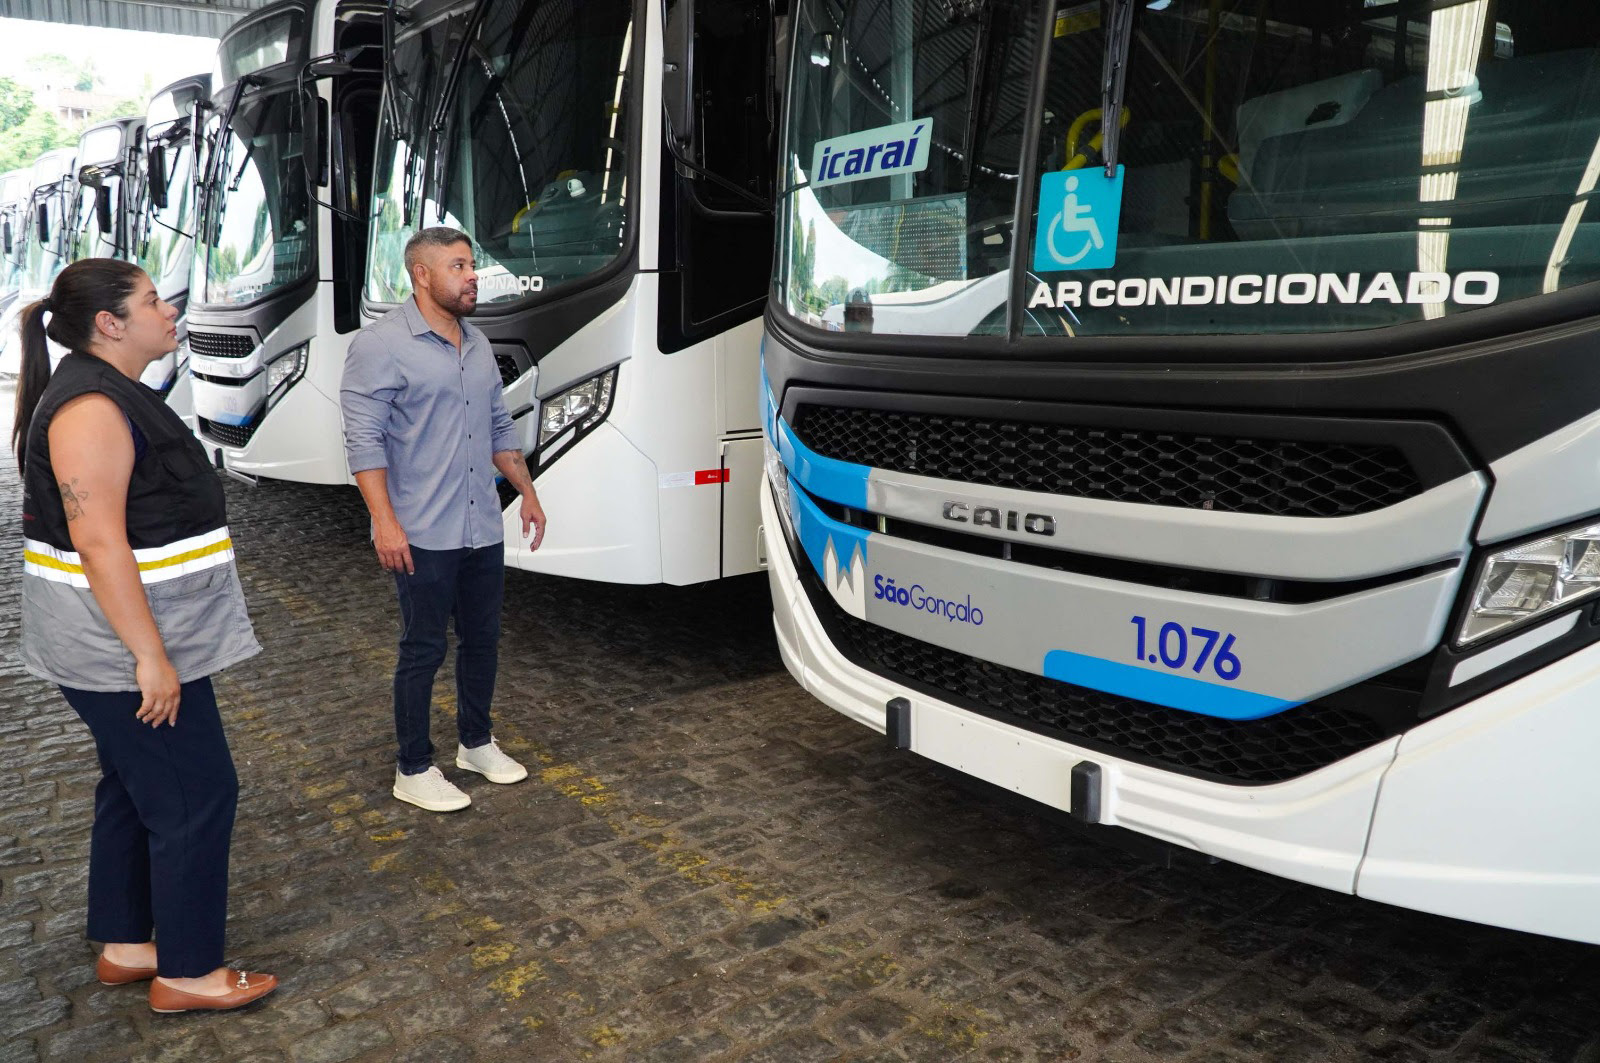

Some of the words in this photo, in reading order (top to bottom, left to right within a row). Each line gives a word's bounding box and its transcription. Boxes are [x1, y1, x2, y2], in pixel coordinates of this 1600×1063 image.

[817, 124, 925, 181] icaraí
[1028, 281, 1082, 308] AR
[1088, 271, 1500, 307] CONDICIONADO
[943, 500, 1056, 537] CAIO
[1130, 615, 1241, 681] 1.076
